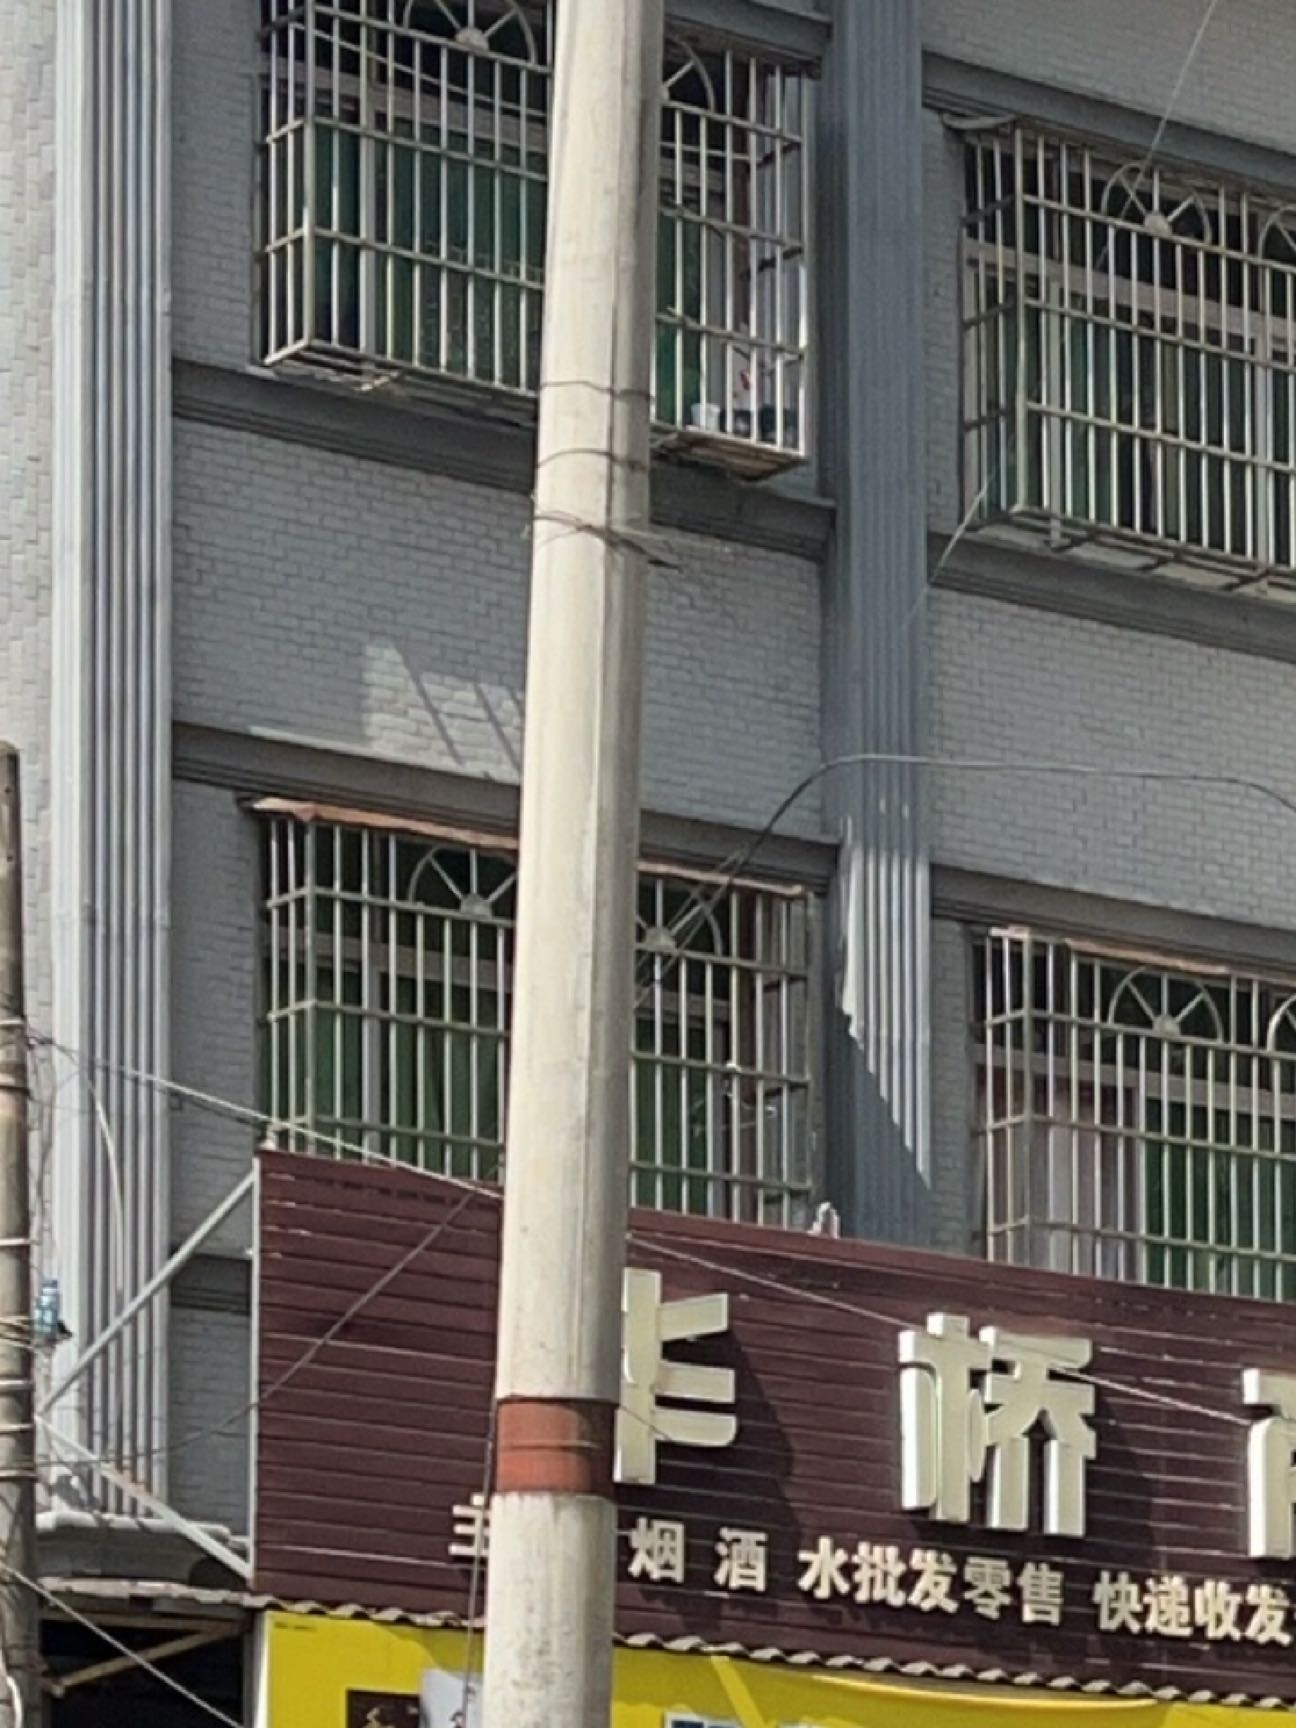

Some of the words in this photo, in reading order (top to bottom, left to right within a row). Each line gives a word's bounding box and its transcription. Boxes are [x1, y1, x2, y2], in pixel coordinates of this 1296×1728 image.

[628, 1517, 686, 1584] 烟
[713, 1526, 768, 1592] 酒
[798, 1536, 1065, 1626] 水批发零售
